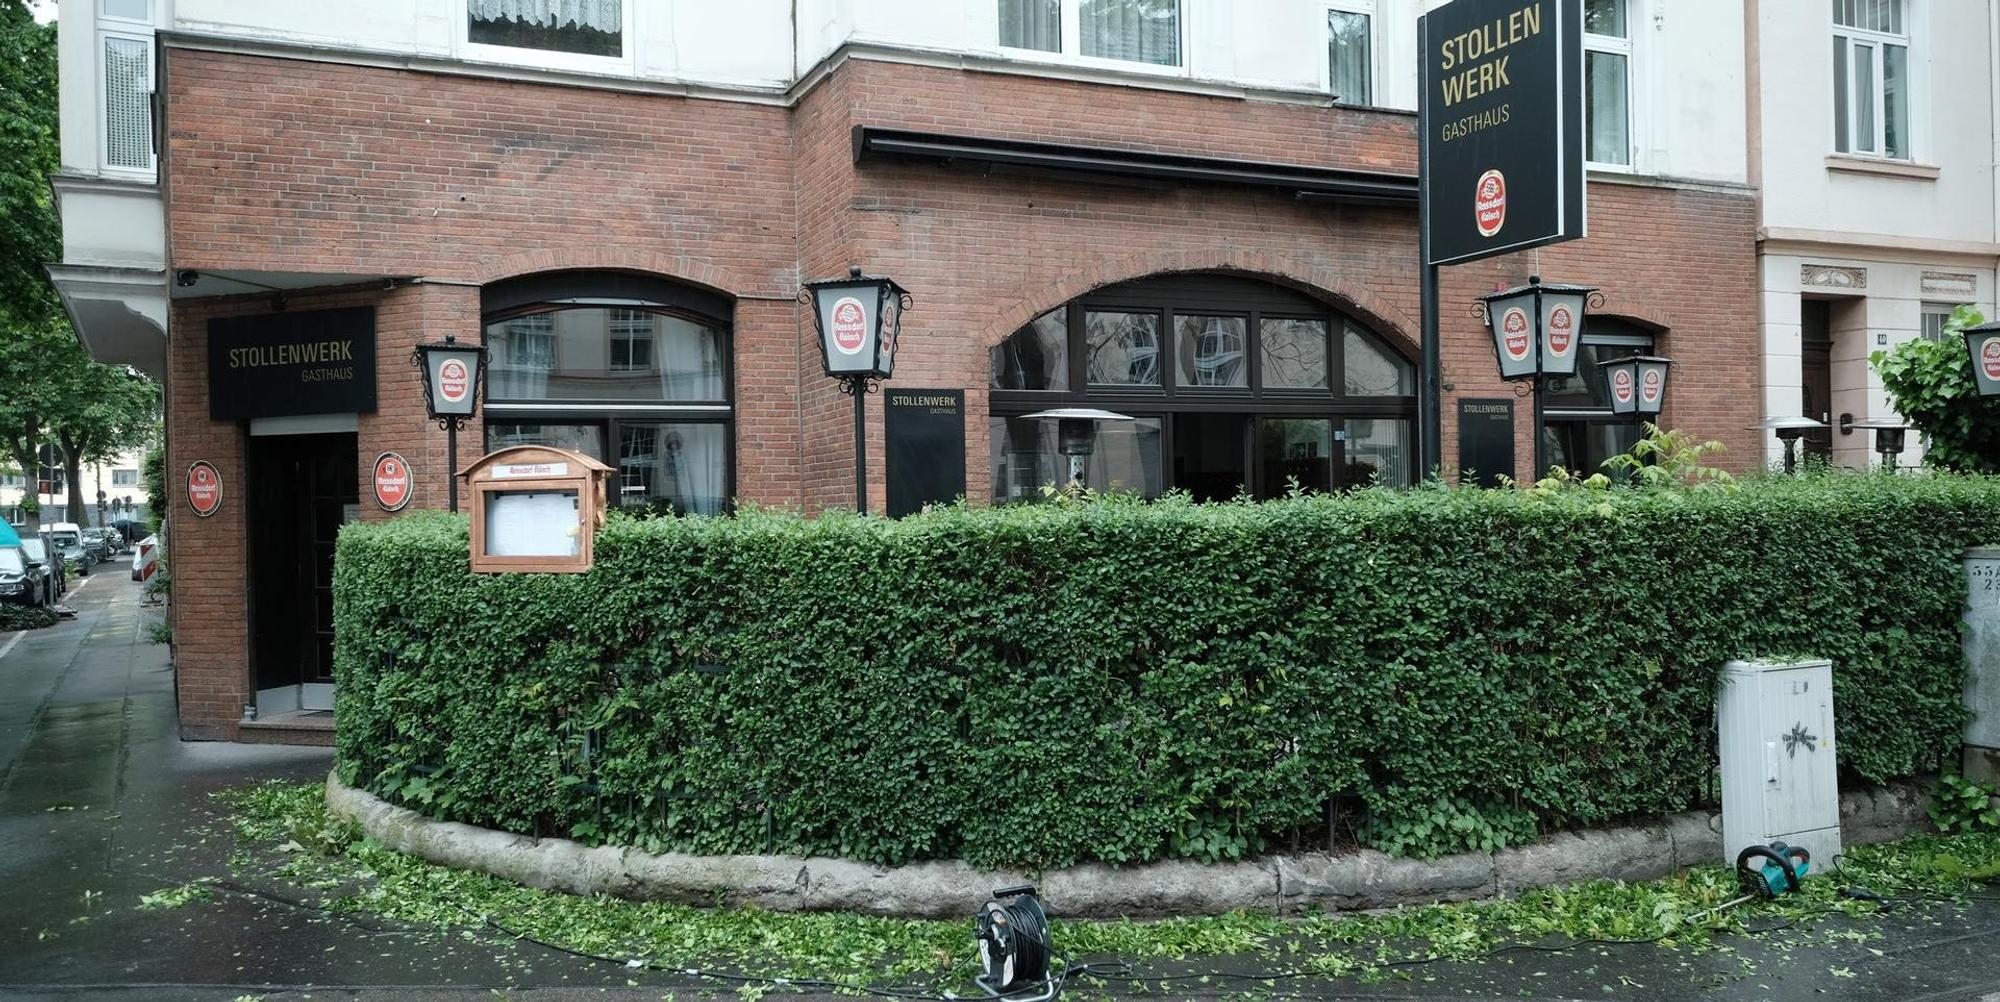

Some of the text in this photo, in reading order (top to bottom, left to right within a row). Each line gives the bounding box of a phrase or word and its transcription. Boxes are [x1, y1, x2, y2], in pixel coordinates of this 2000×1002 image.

[1441, 3, 1541, 70] STOLLEN
[1441, 55, 1511, 107] WERK
[1442, 104, 1511, 142] GASTHAUS
[229, 340, 353, 368] STOLLENWERK
[302, 366, 353, 382] GASTHAUS
[892, 395, 957, 406] STOLLENWERK
